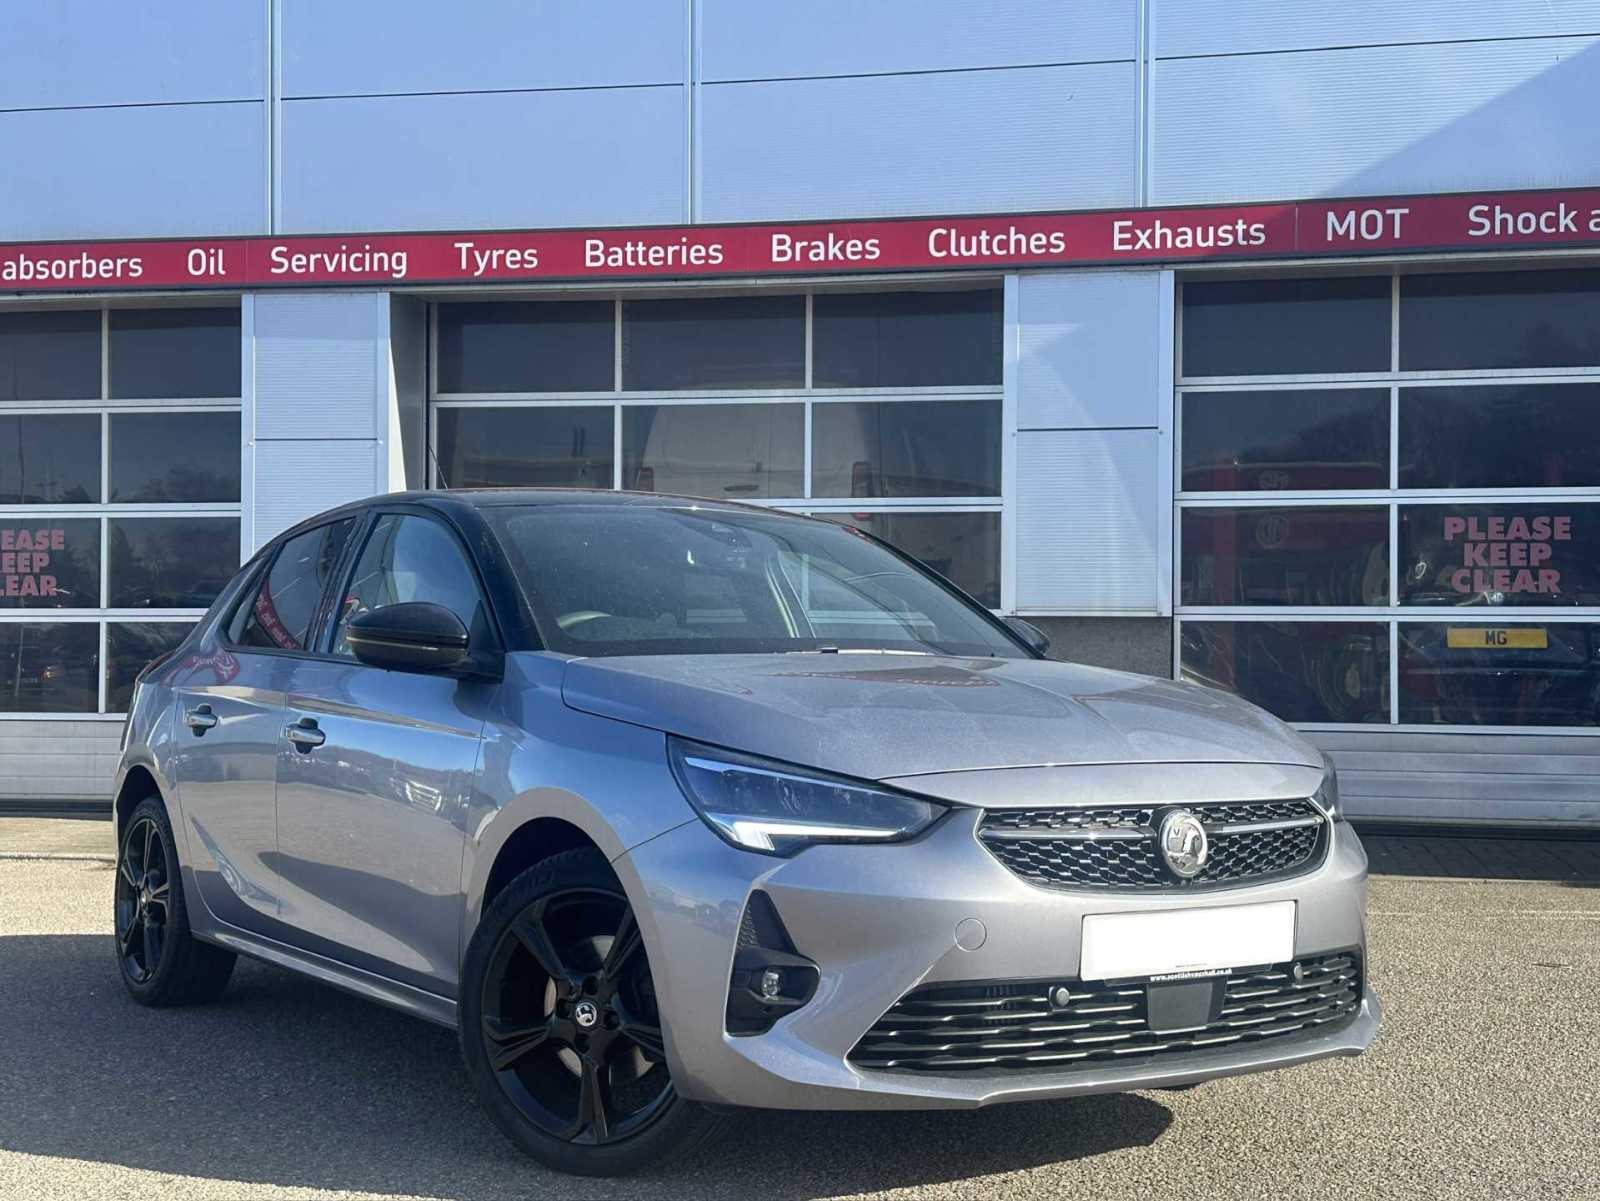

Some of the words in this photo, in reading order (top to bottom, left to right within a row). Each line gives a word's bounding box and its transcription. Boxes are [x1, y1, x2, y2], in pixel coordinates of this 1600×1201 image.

[2, 252, 143, 280] absorbers
[187, 248, 226, 276] Oil
[270, 245, 408, 278] Servicing
[454, 242, 539, 277] Tyres
[585, 237, 724, 267] Batteries
[771, 233, 881, 262] Brakes
[928, 226, 1066, 258] Clutches
[1113, 218, 1266, 251] Exhausts
[1326, 208, 1410, 241] MOT
[1468, 203, 1578, 236] Shock
[1444, 516, 1572, 540] PLEASE
[1464, 542, 1553, 567] KEEP
[1451, 569, 1561, 593] CLEAR
[1485, 631, 1508, 646] MG
